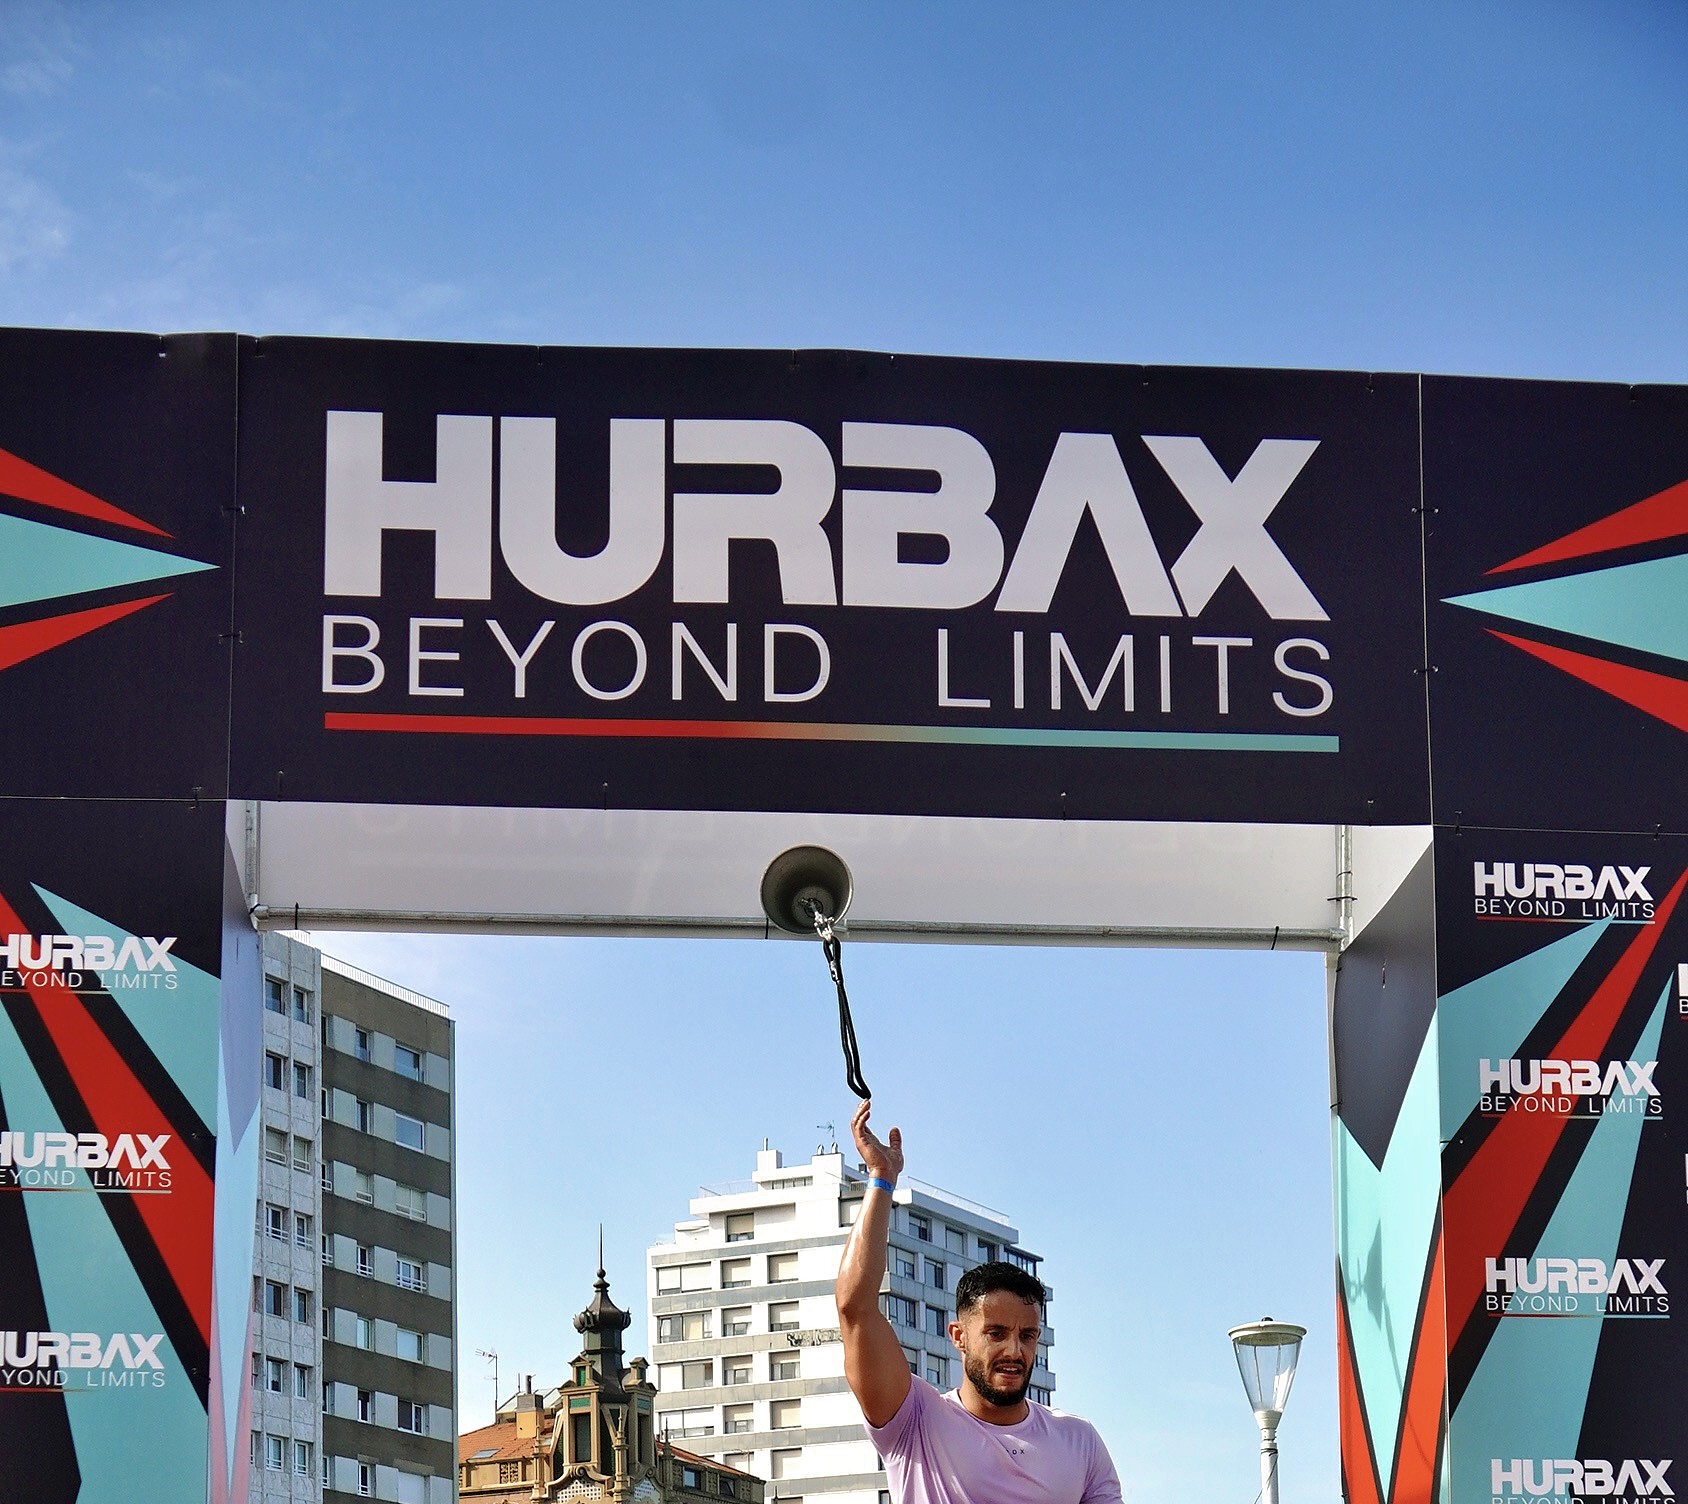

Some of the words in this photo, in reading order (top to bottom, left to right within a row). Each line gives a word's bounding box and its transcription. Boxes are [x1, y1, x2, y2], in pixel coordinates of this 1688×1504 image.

[324, 410, 1331, 621] HURBAX
[322, 614, 830, 702] BEYOND
[937, 628, 1334, 717] LIMITS
[1474, 861, 1652, 901] HURBAX
[1474, 898, 1566, 917] BEYOND
[1582, 900, 1655, 918] LIMITS
[1, 971, 83, 989] EYOND
[100, 973, 178, 990] LIMITS
[1480, 1058, 1660, 1096] HURBAX
[1480, 1095, 1573, 1113] BEYOND
[1588, 1096, 1663, 1114] LIMITS
[93, 1171, 172, 1188] LIMITS
[1485, 1257, 1666, 1294] HURBAX
[1486, 1295, 1578, 1313] BEYOND
[1595, 1296, 1669, 1313] LIMITS
[0, 1331, 166, 1370] URBAX
[1, 1369, 70, 1386] YOND
[86, 1370, 166, 1388] LIMITS
[1490, 1459, 1674, 1496] HURBAX
